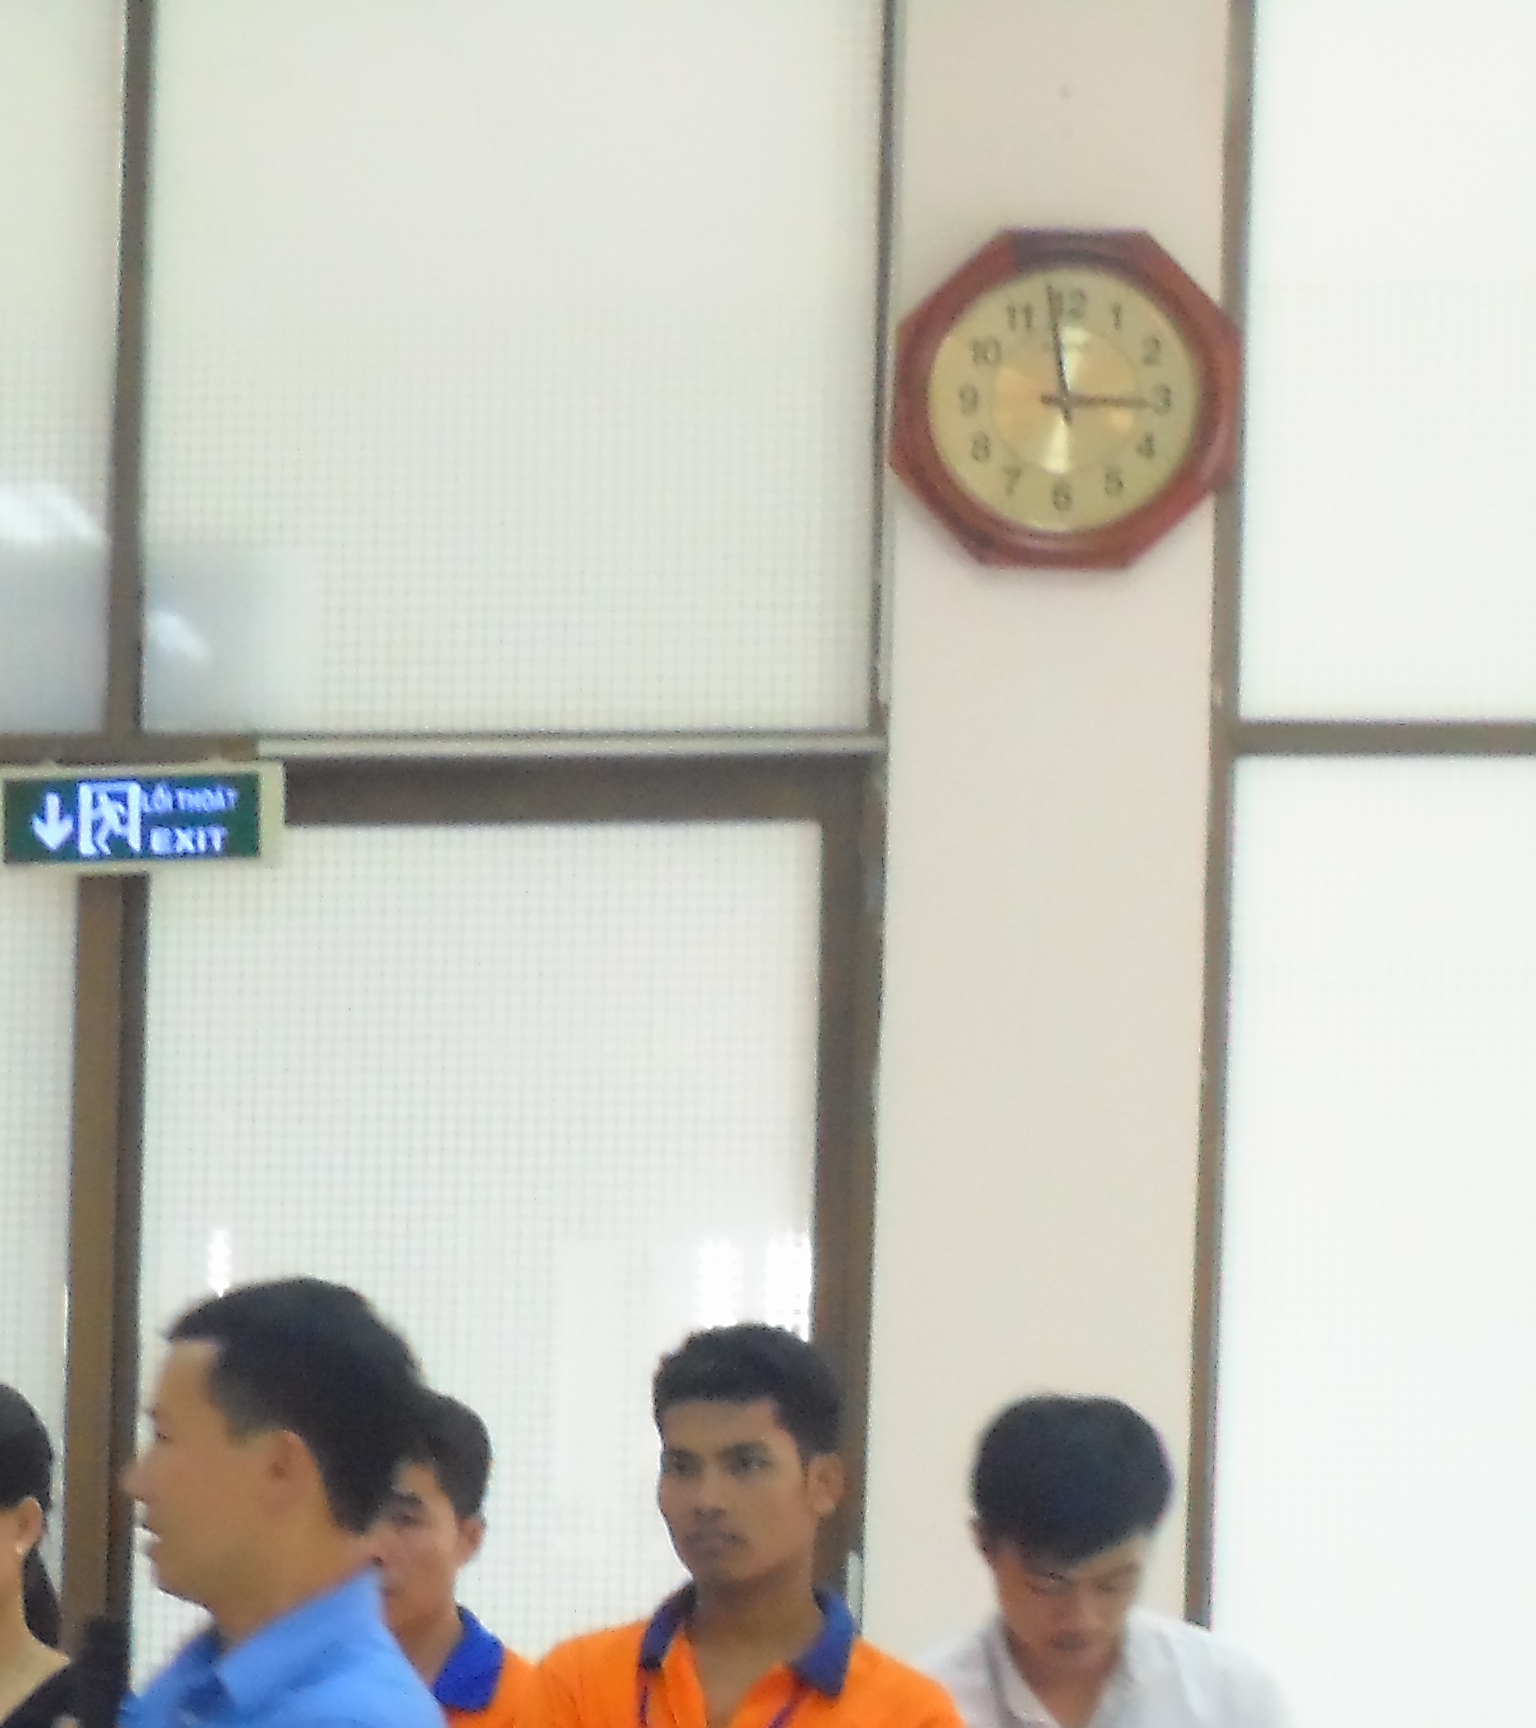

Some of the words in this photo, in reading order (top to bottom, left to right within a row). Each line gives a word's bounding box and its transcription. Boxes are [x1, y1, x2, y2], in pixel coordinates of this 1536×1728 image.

[1006, 303, 1035, 331] 11
[1112, 303, 1123, 330] 1
[971, 337, 1002, 367] 10
[1141, 336, 1162, 366] 2
[959, 383, 979, 416] 9
[970, 431, 991, 463] 8
[1136, 432, 1155, 460] 4
[1003, 463, 1023, 496] 7
[1052, 479, 1072, 512] 6
[150, 826, 227, 854] EXIT
